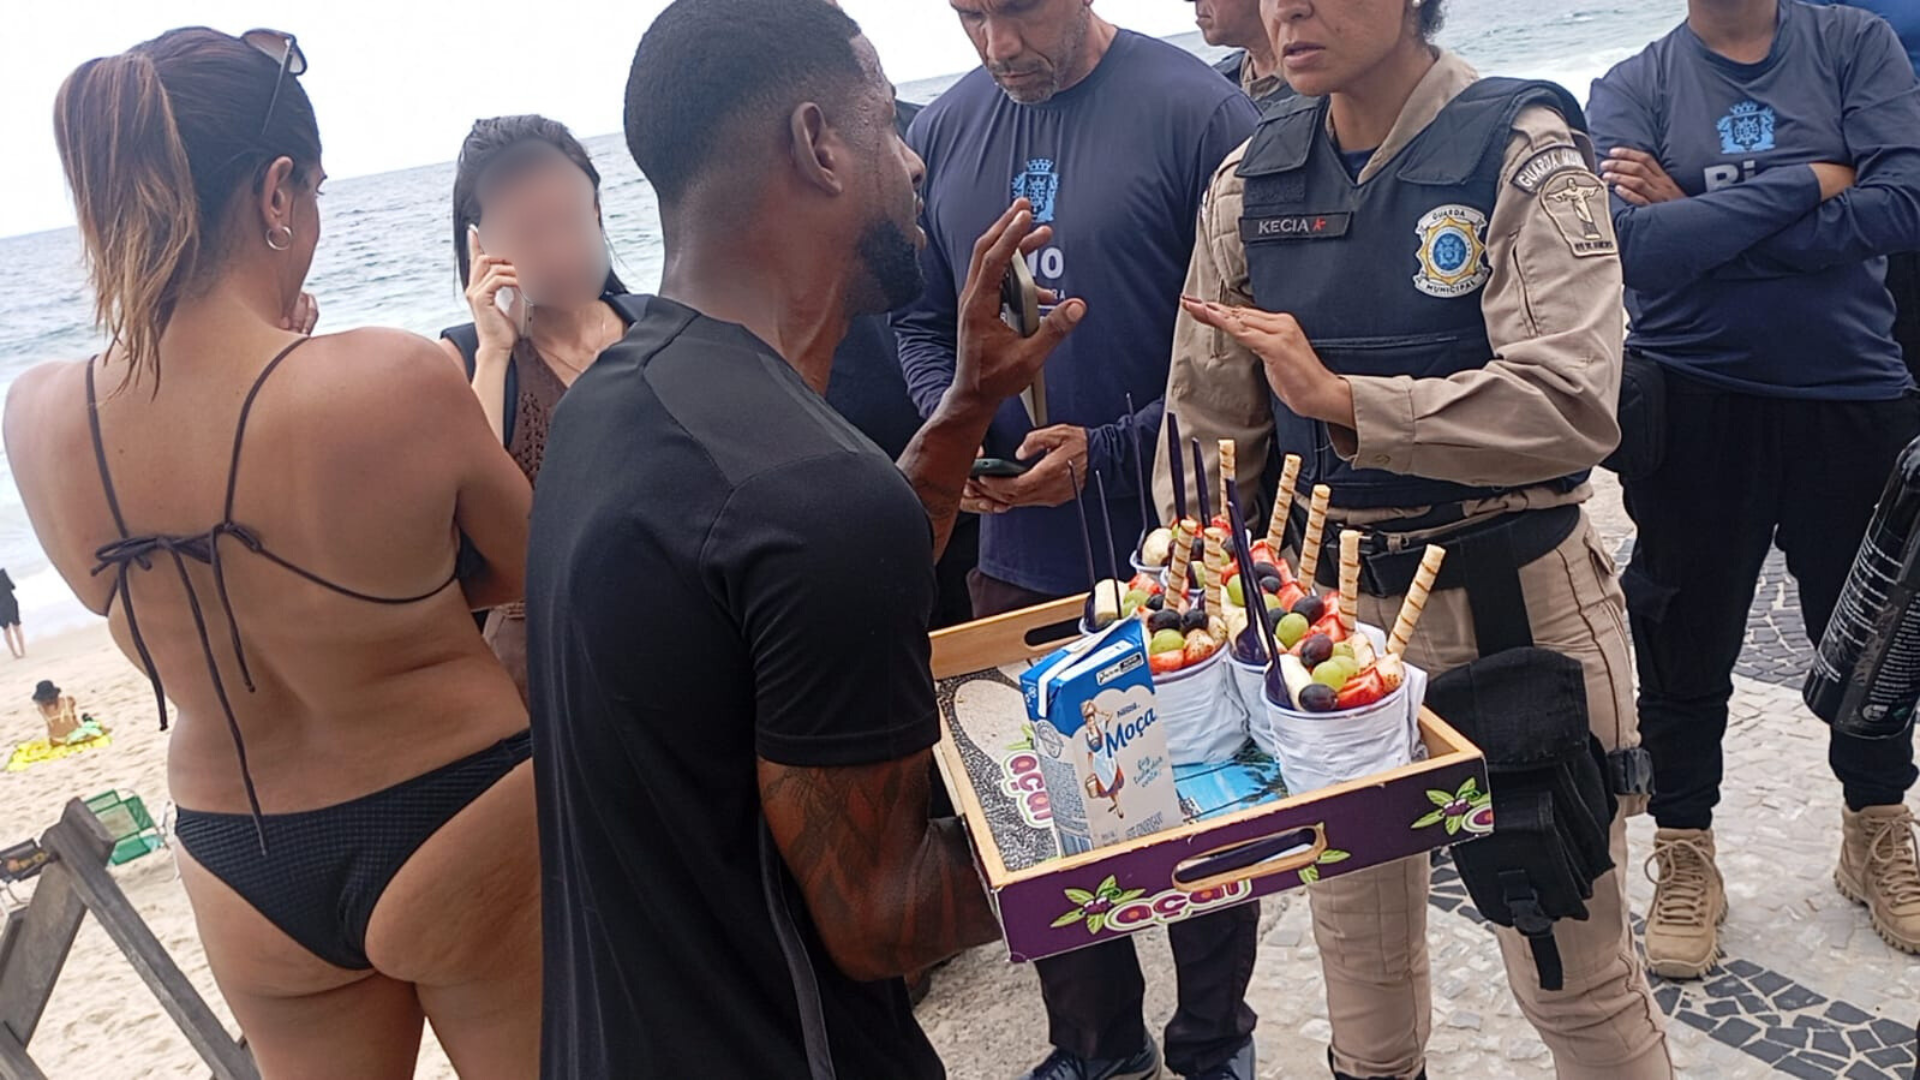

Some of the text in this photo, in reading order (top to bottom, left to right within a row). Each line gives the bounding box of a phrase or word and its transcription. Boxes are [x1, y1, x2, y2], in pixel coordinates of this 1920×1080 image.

[1518, 153, 1559, 188] GUARDA
[1432, 209, 1466, 220] GUARDA
[1258, 218, 1309, 234] KECIA
[1426, 280, 1477, 294] MUNICIPAL
[1104, 708, 1156, 758] Moça
